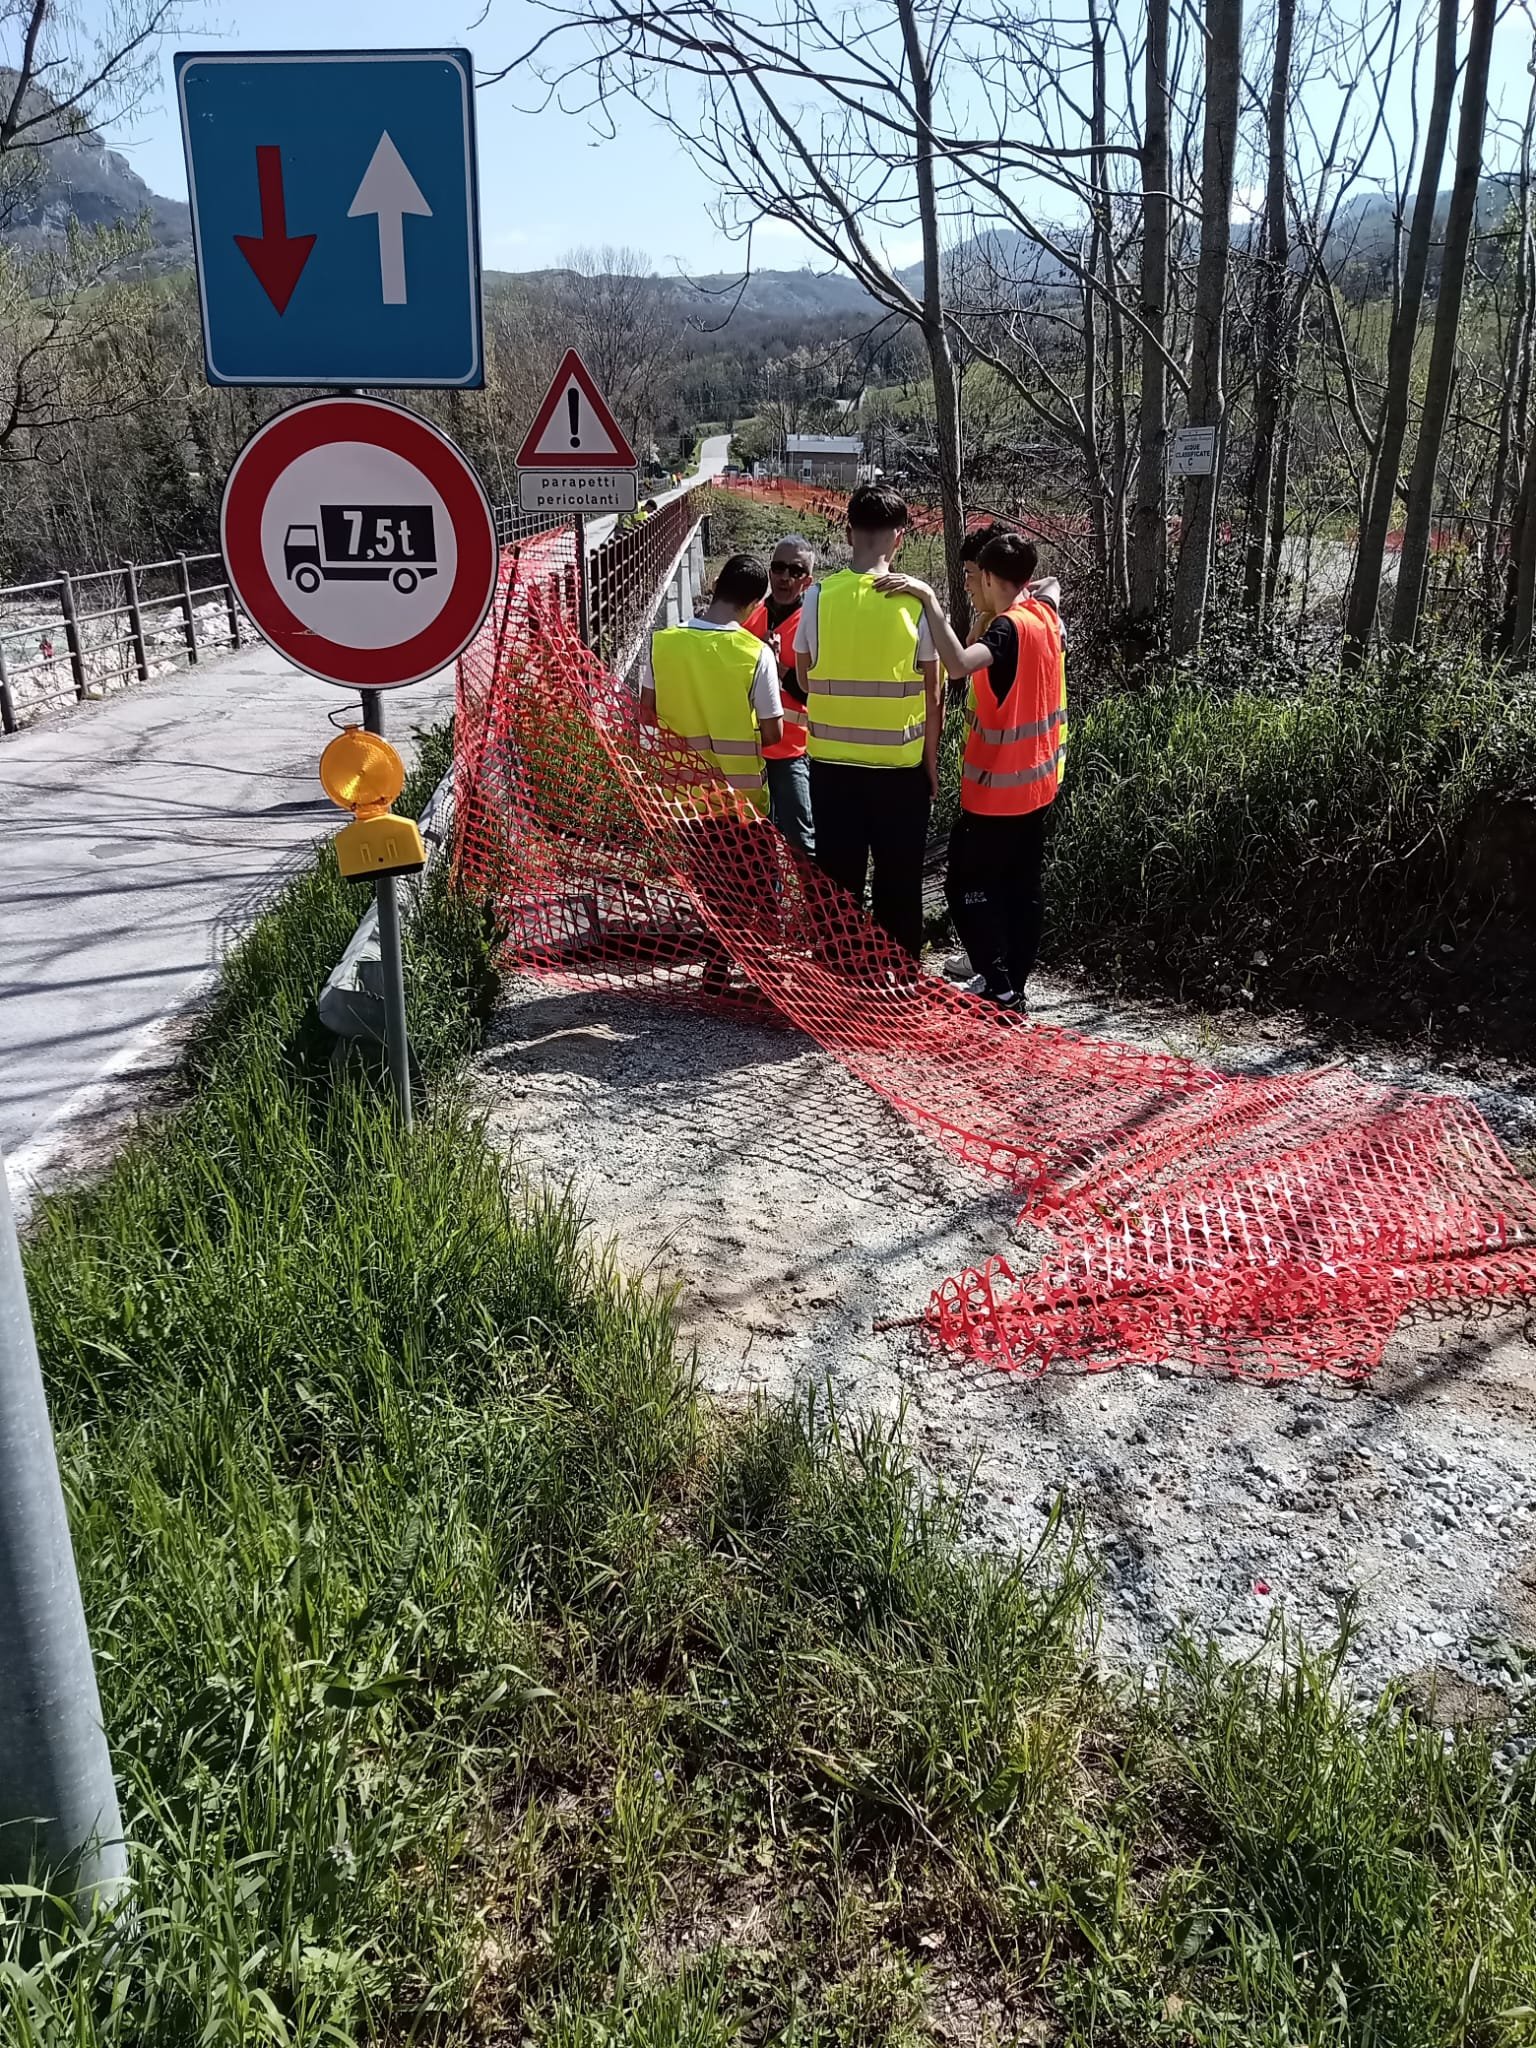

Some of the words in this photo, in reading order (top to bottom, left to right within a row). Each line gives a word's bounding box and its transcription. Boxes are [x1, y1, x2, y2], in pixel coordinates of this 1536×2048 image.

[1187, 457, 1193, 466] C
[542, 476, 616, 488] parapetti
[537, 493, 619, 506] pericolanti
[343, 510, 415, 559] 7,5t
